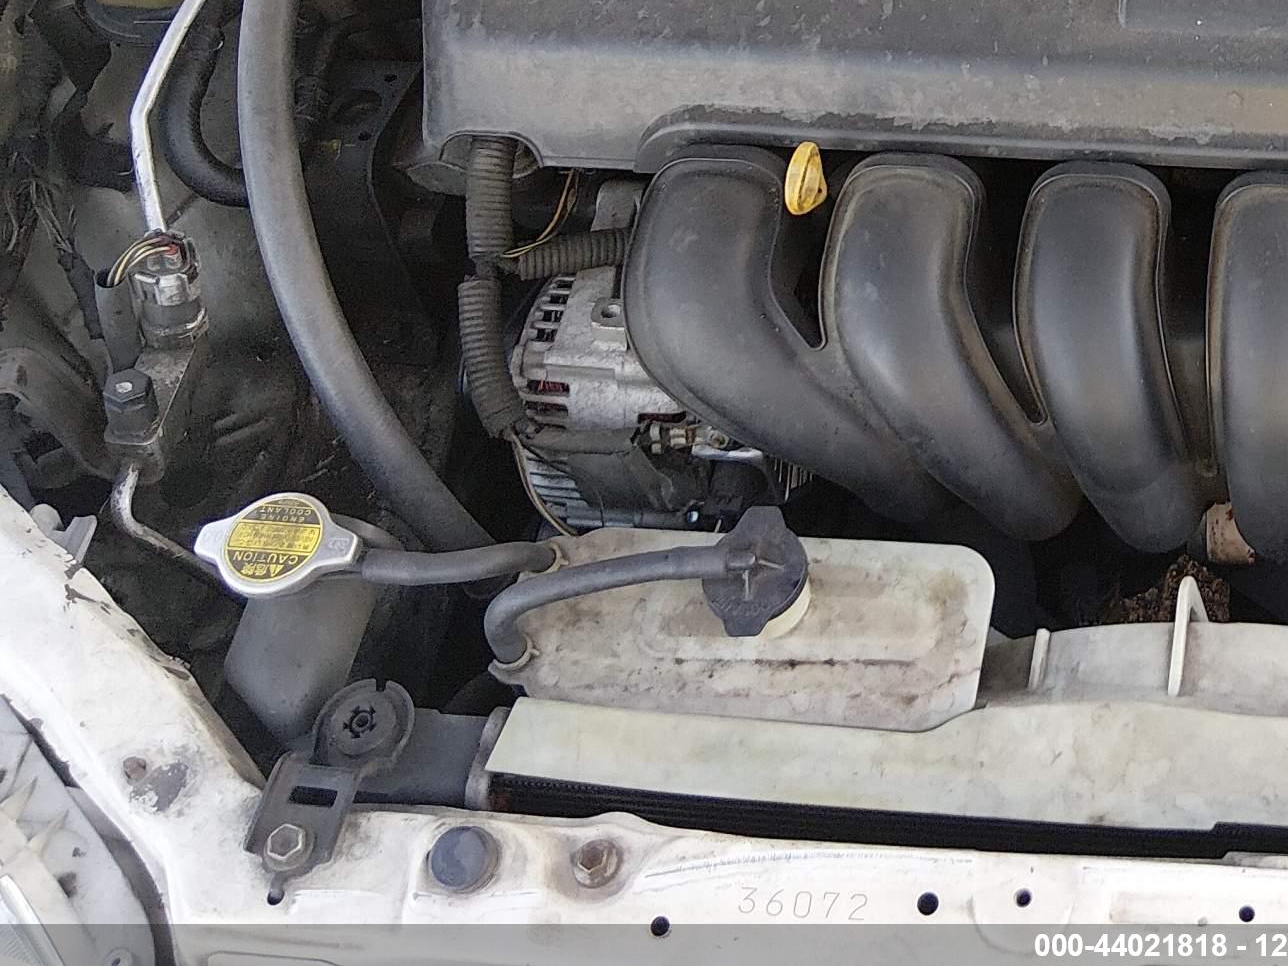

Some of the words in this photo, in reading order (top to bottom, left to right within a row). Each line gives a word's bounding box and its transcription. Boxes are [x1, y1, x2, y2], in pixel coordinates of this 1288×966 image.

[258, 506, 312, 516] COOLANT
[258, 513, 304, 523] ENGINE
[233, 551, 298, 564] CAUTION
[738, 886, 868, 921] 36072
